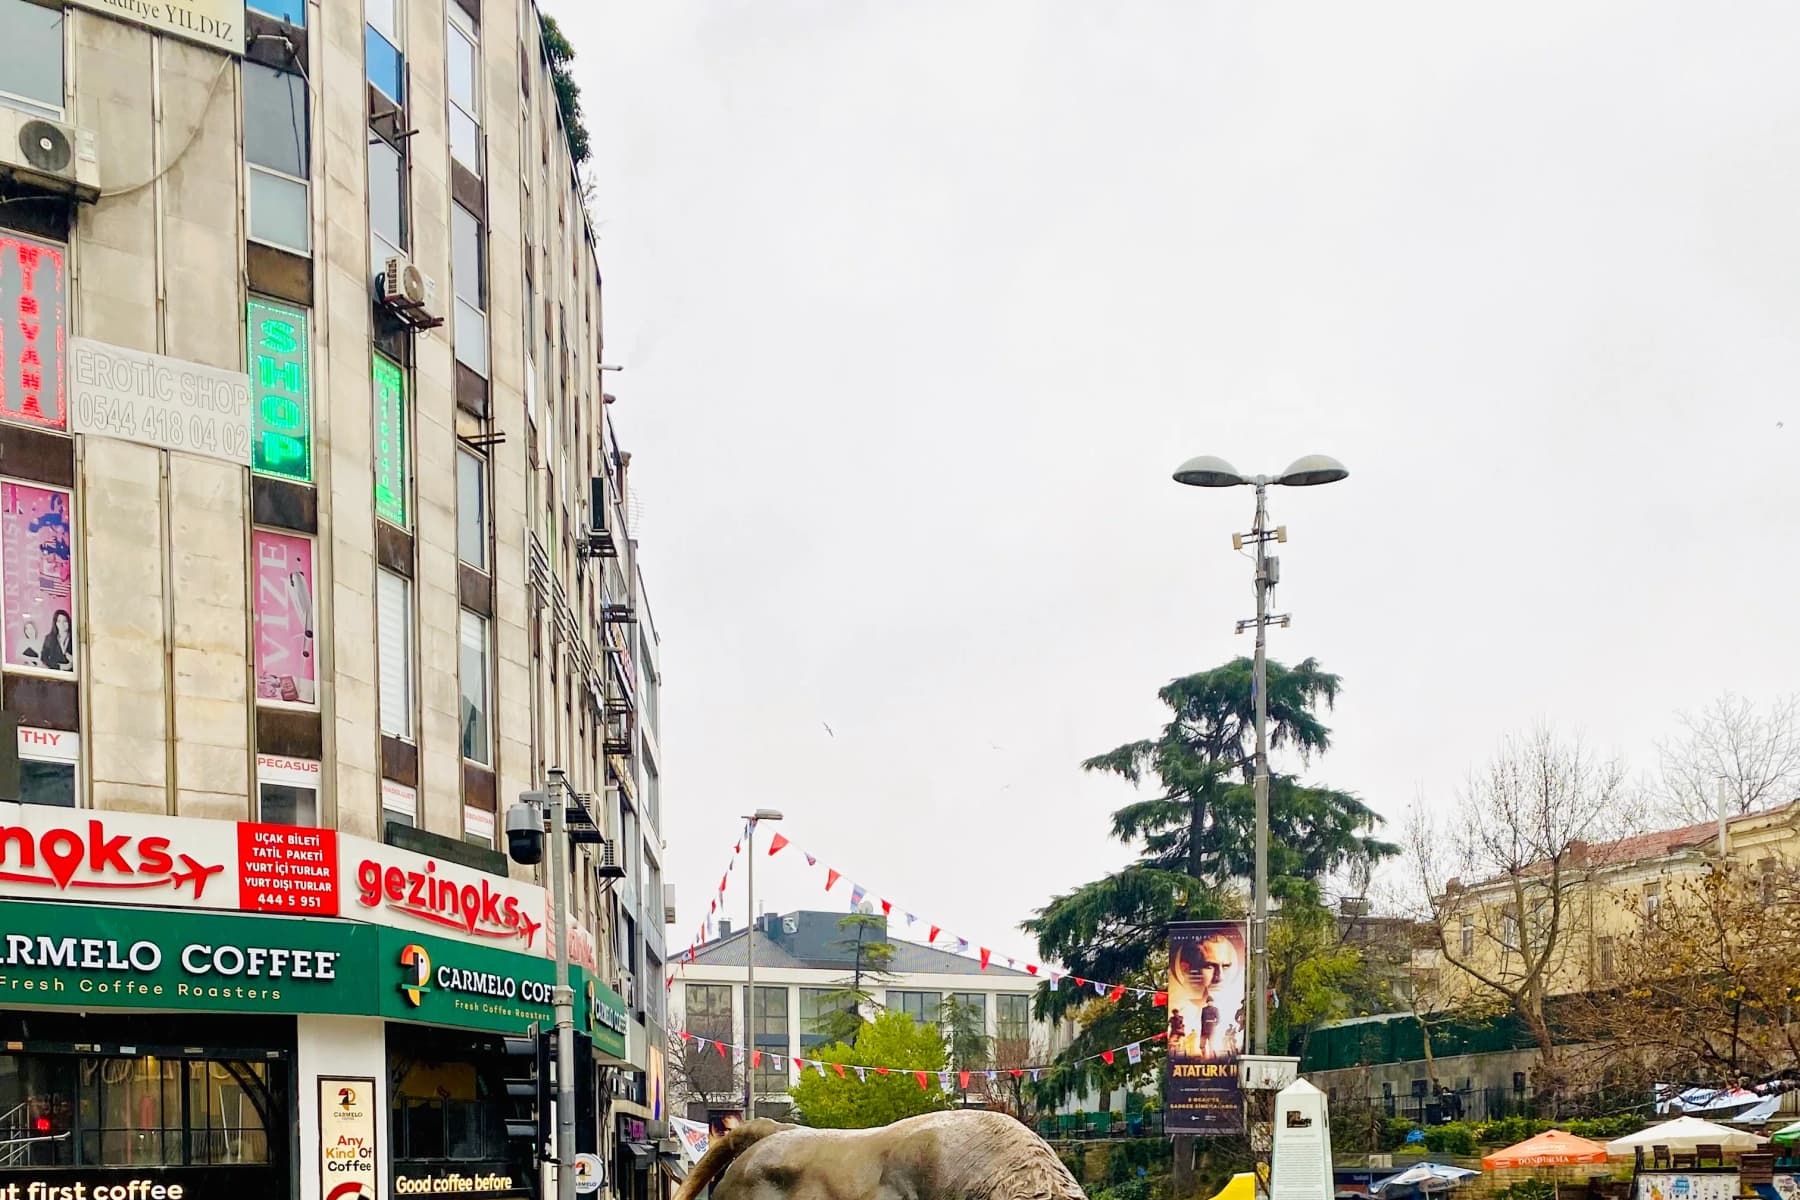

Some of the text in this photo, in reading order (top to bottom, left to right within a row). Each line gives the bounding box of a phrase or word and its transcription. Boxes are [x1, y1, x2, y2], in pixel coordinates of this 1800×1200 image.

[103, 0, 233, 42] adriye YILDIZ
[180, 372, 248, 416] SHOP
[258, 318, 303, 464] SHOP
[78, 391, 249, 458] 0544 418 04 02
[20, 730, 61, 746] THY
[257, 757, 319, 773] PEGASUS
[255, 832, 320, 847] UÇAK BİLETİ
[252, 846, 323, 862] TATİL PAKETİ
[246, 862, 273, 873] YURT
[290, 865, 330, 877] TURLAR
[245, 877, 332, 892] YURT DIŞI TURLAR
[258, 893, 321, 908] 444 5 951
[358, 859, 520, 936] gezinoks
[182, 944, 336, 979] COFFEE
[79, 979, 163, 995] Coffee
[178, 983, 281, 1000] Roasters
[437, 966, 556, 1003] CARMELO COF
[454, 1000, 480, 1012] Fresh
[482, 1003, 513, 1017] Coffee
[1172, 1064, 1228, 1078] ATATÜRK
[337, 1135, 364, 1148] Any
[326, 1147, 373, 1159] Kind Of
[1518, 1155, 1569, 1167] DONDURMA
[327, 1160, 372, 1172] Coffee
[396, 1172, 513, 1194] Good coffee before
